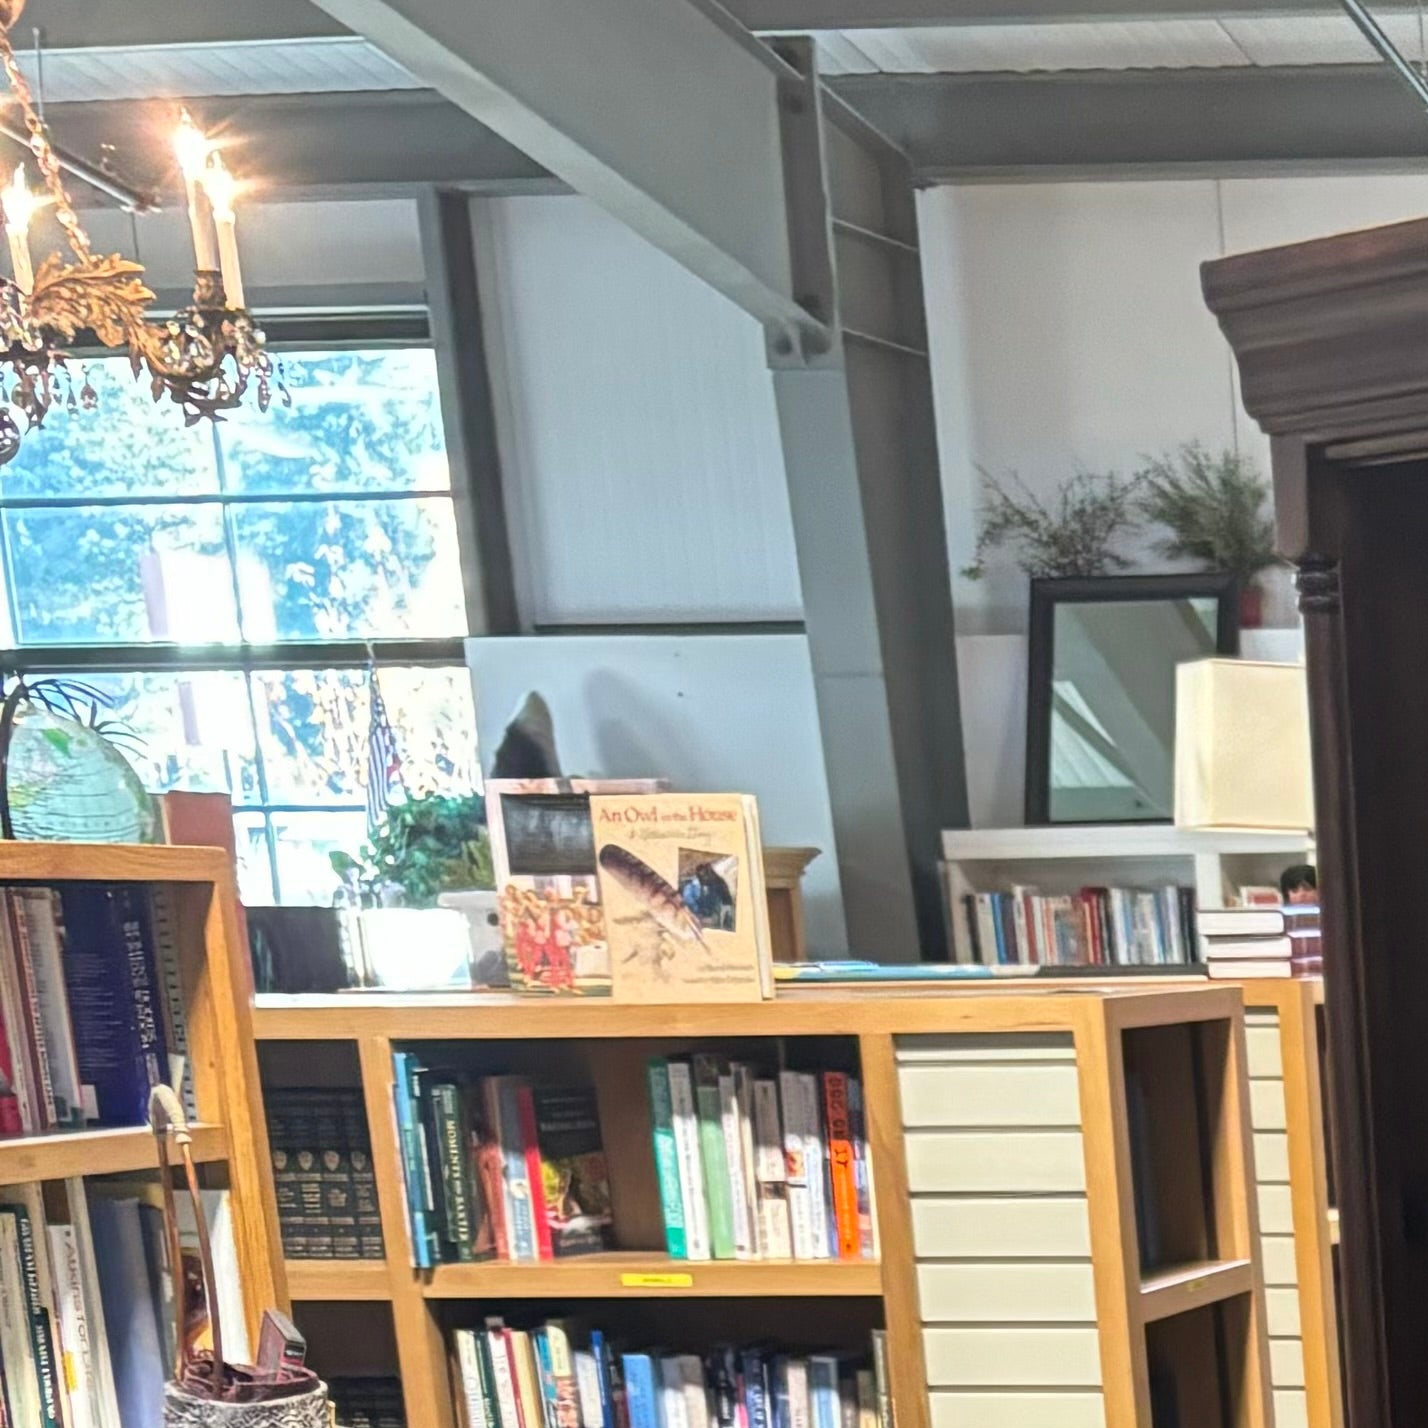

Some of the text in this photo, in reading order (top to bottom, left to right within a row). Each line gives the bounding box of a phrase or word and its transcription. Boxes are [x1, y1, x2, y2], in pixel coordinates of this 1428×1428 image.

[600, 807, 622, 823] An
[624, 806, 658, 823] Owl
[689, 805, 737, 822] House
